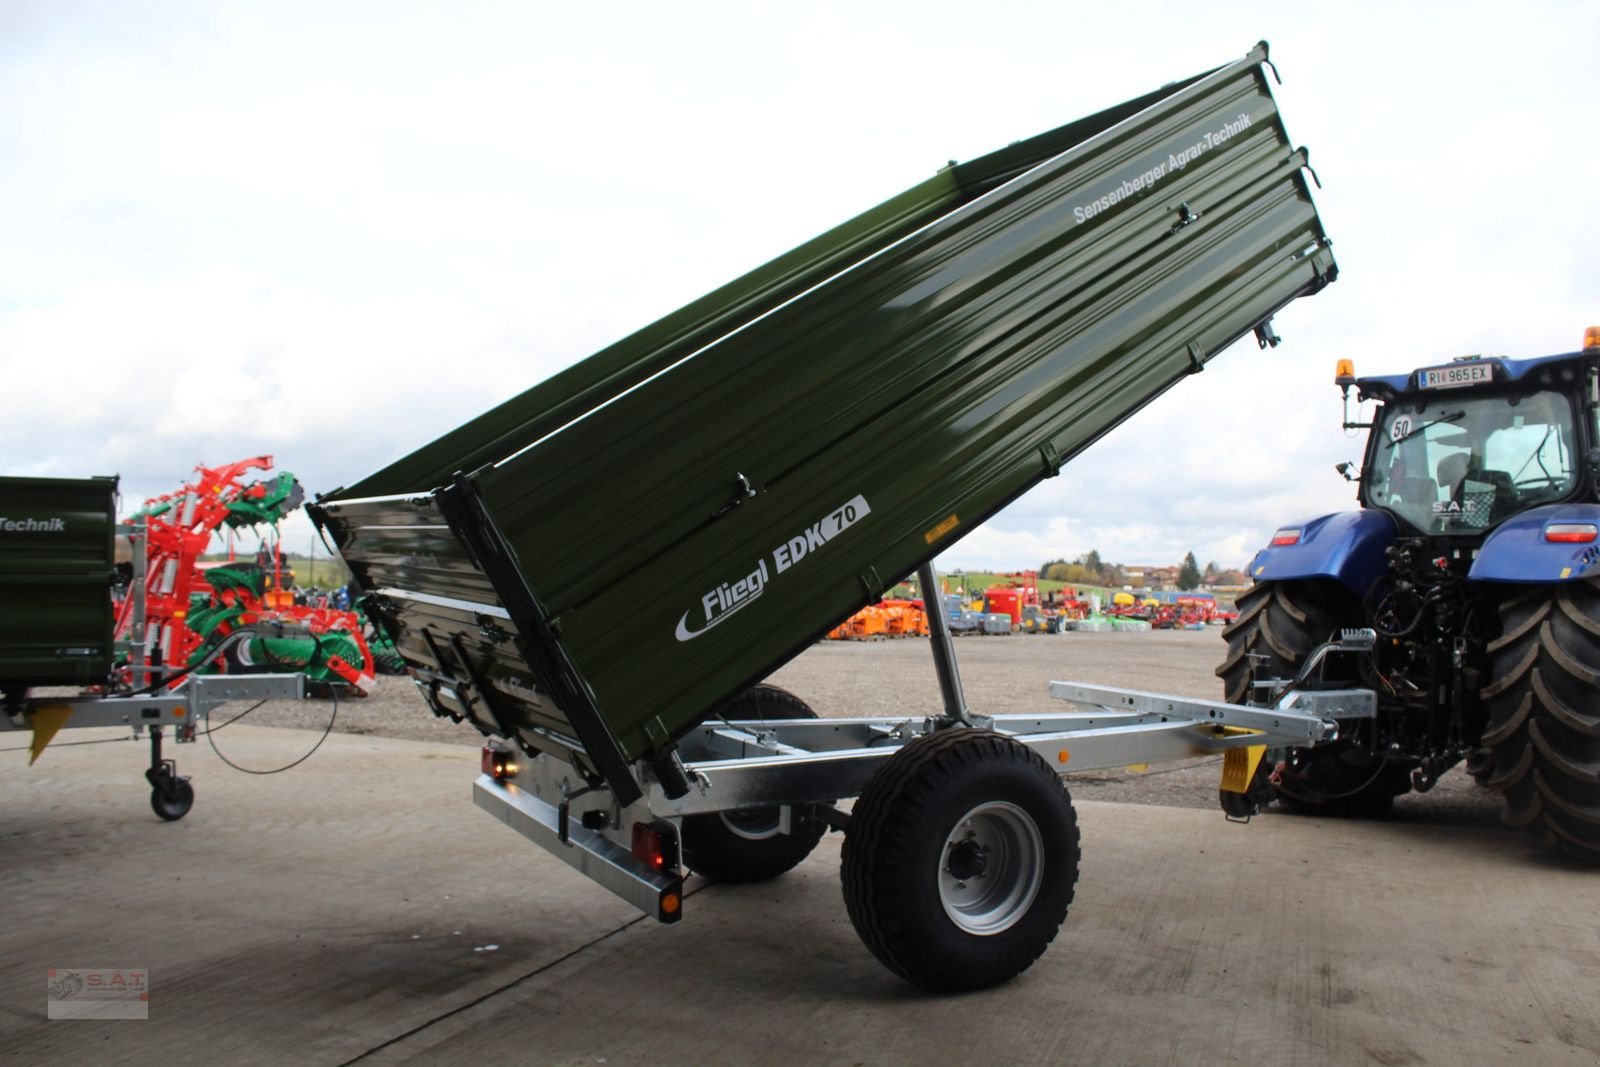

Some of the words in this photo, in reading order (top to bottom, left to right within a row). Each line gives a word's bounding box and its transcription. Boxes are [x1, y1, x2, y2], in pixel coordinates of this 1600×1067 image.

[1073, 162, 1166, 224] Sensenberger
[1168, 112, 1252, 170] Agrar-Technik
[1393, 420, 1408, 438] 50
[702, 558, 769, 621] Fliegl
[772, 522, 826, 574] EDK
[832, 504, 857, 531] 70
